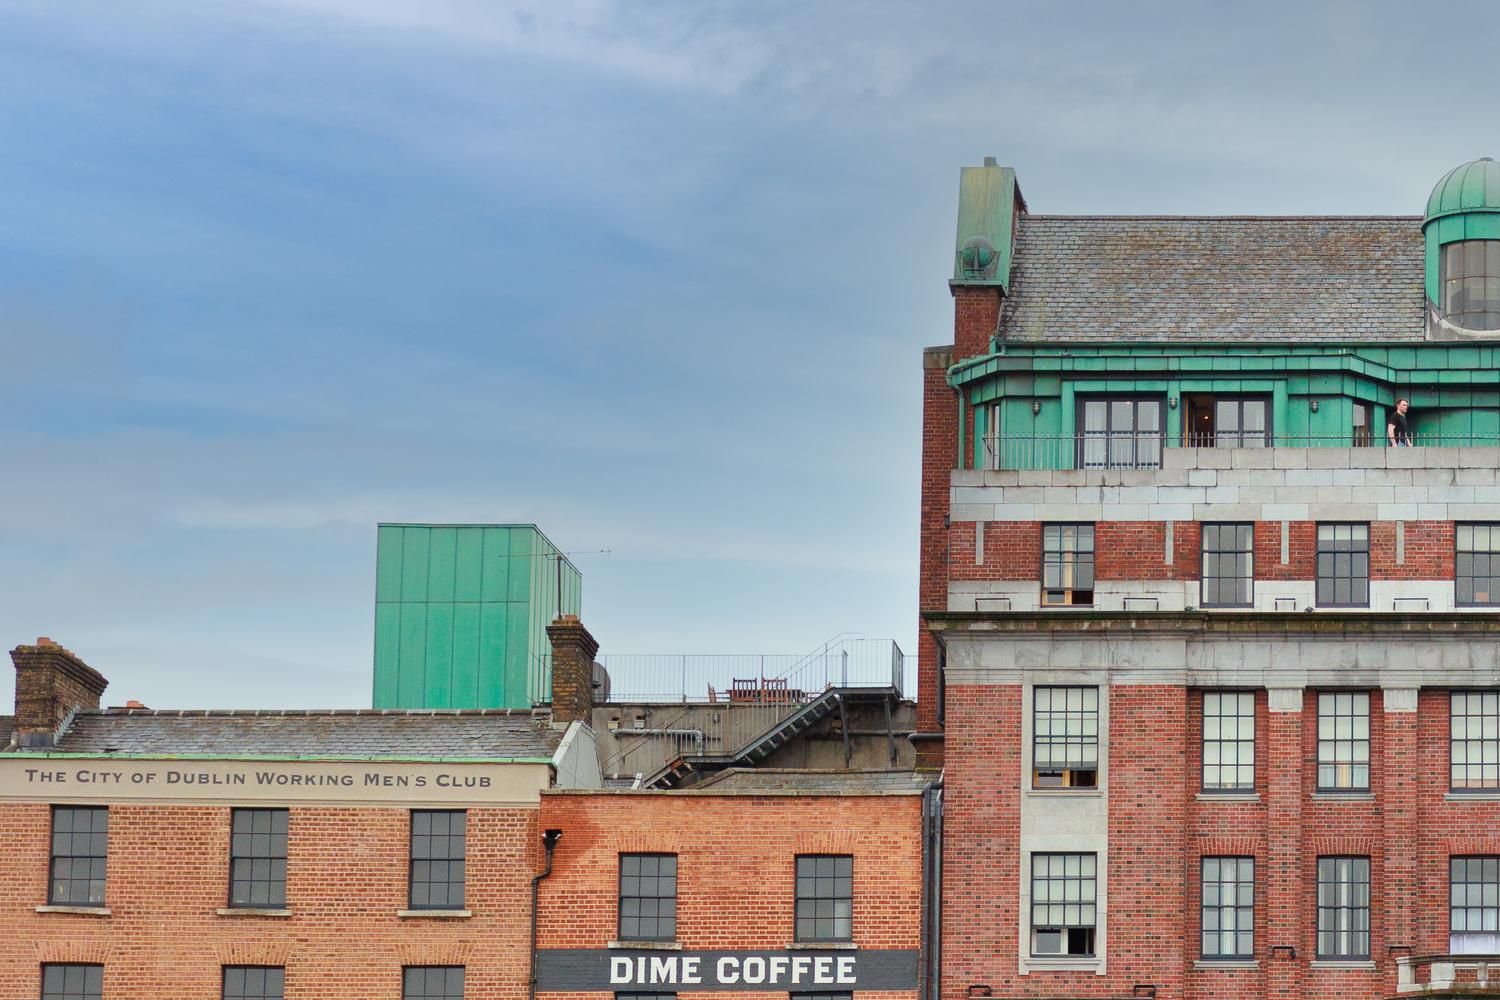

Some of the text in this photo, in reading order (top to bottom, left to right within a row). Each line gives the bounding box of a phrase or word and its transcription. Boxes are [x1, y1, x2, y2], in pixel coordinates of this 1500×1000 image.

[25, 769, 66, 783] THE
[76, 770, 123, 783] CITY
[131, 772, 156, 784] OF
[166, 771, 245, 785] DUBLIN
[256, 772, 353, 786] WORKING
[436, 774, 491, 788] CLUB
[609, 956, 857, 984] DIME COFFEE
